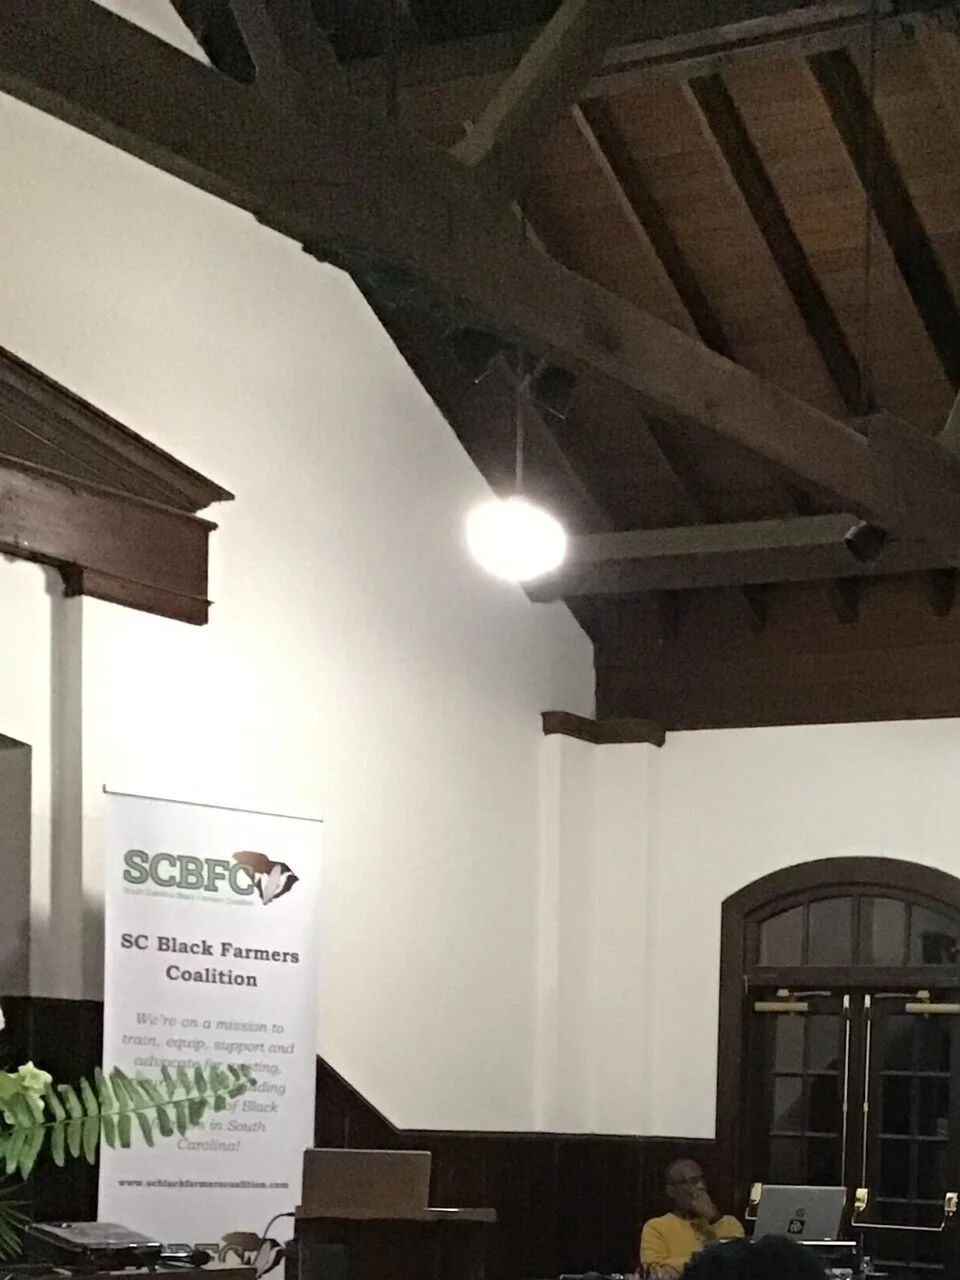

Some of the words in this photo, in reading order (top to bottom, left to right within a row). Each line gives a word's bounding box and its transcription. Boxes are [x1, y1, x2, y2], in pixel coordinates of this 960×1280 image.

[123, 849, 254, 896] SCBFC
[121, 933, 149, 950] SC
[157, 936, 214, 956] Black
[220, 942, 300, 964] Farmers
[166, 965, 258, 987] Coalition
[136, 1012, 177, 1027] We're
[181, 1018, 198, 1029] on
[203, 1020, 211, 1029] a
[216, 1021, 268, 1033] mission
[272, 1023, 284, 1034] to
[214, 1041, 264, 1054] support
[268, 1043, 295, 1054] and
[241, 1100, 278, 1113] Black
[210, 1119, 223, 1131] in
[227, 1119, 266, 1132] South
